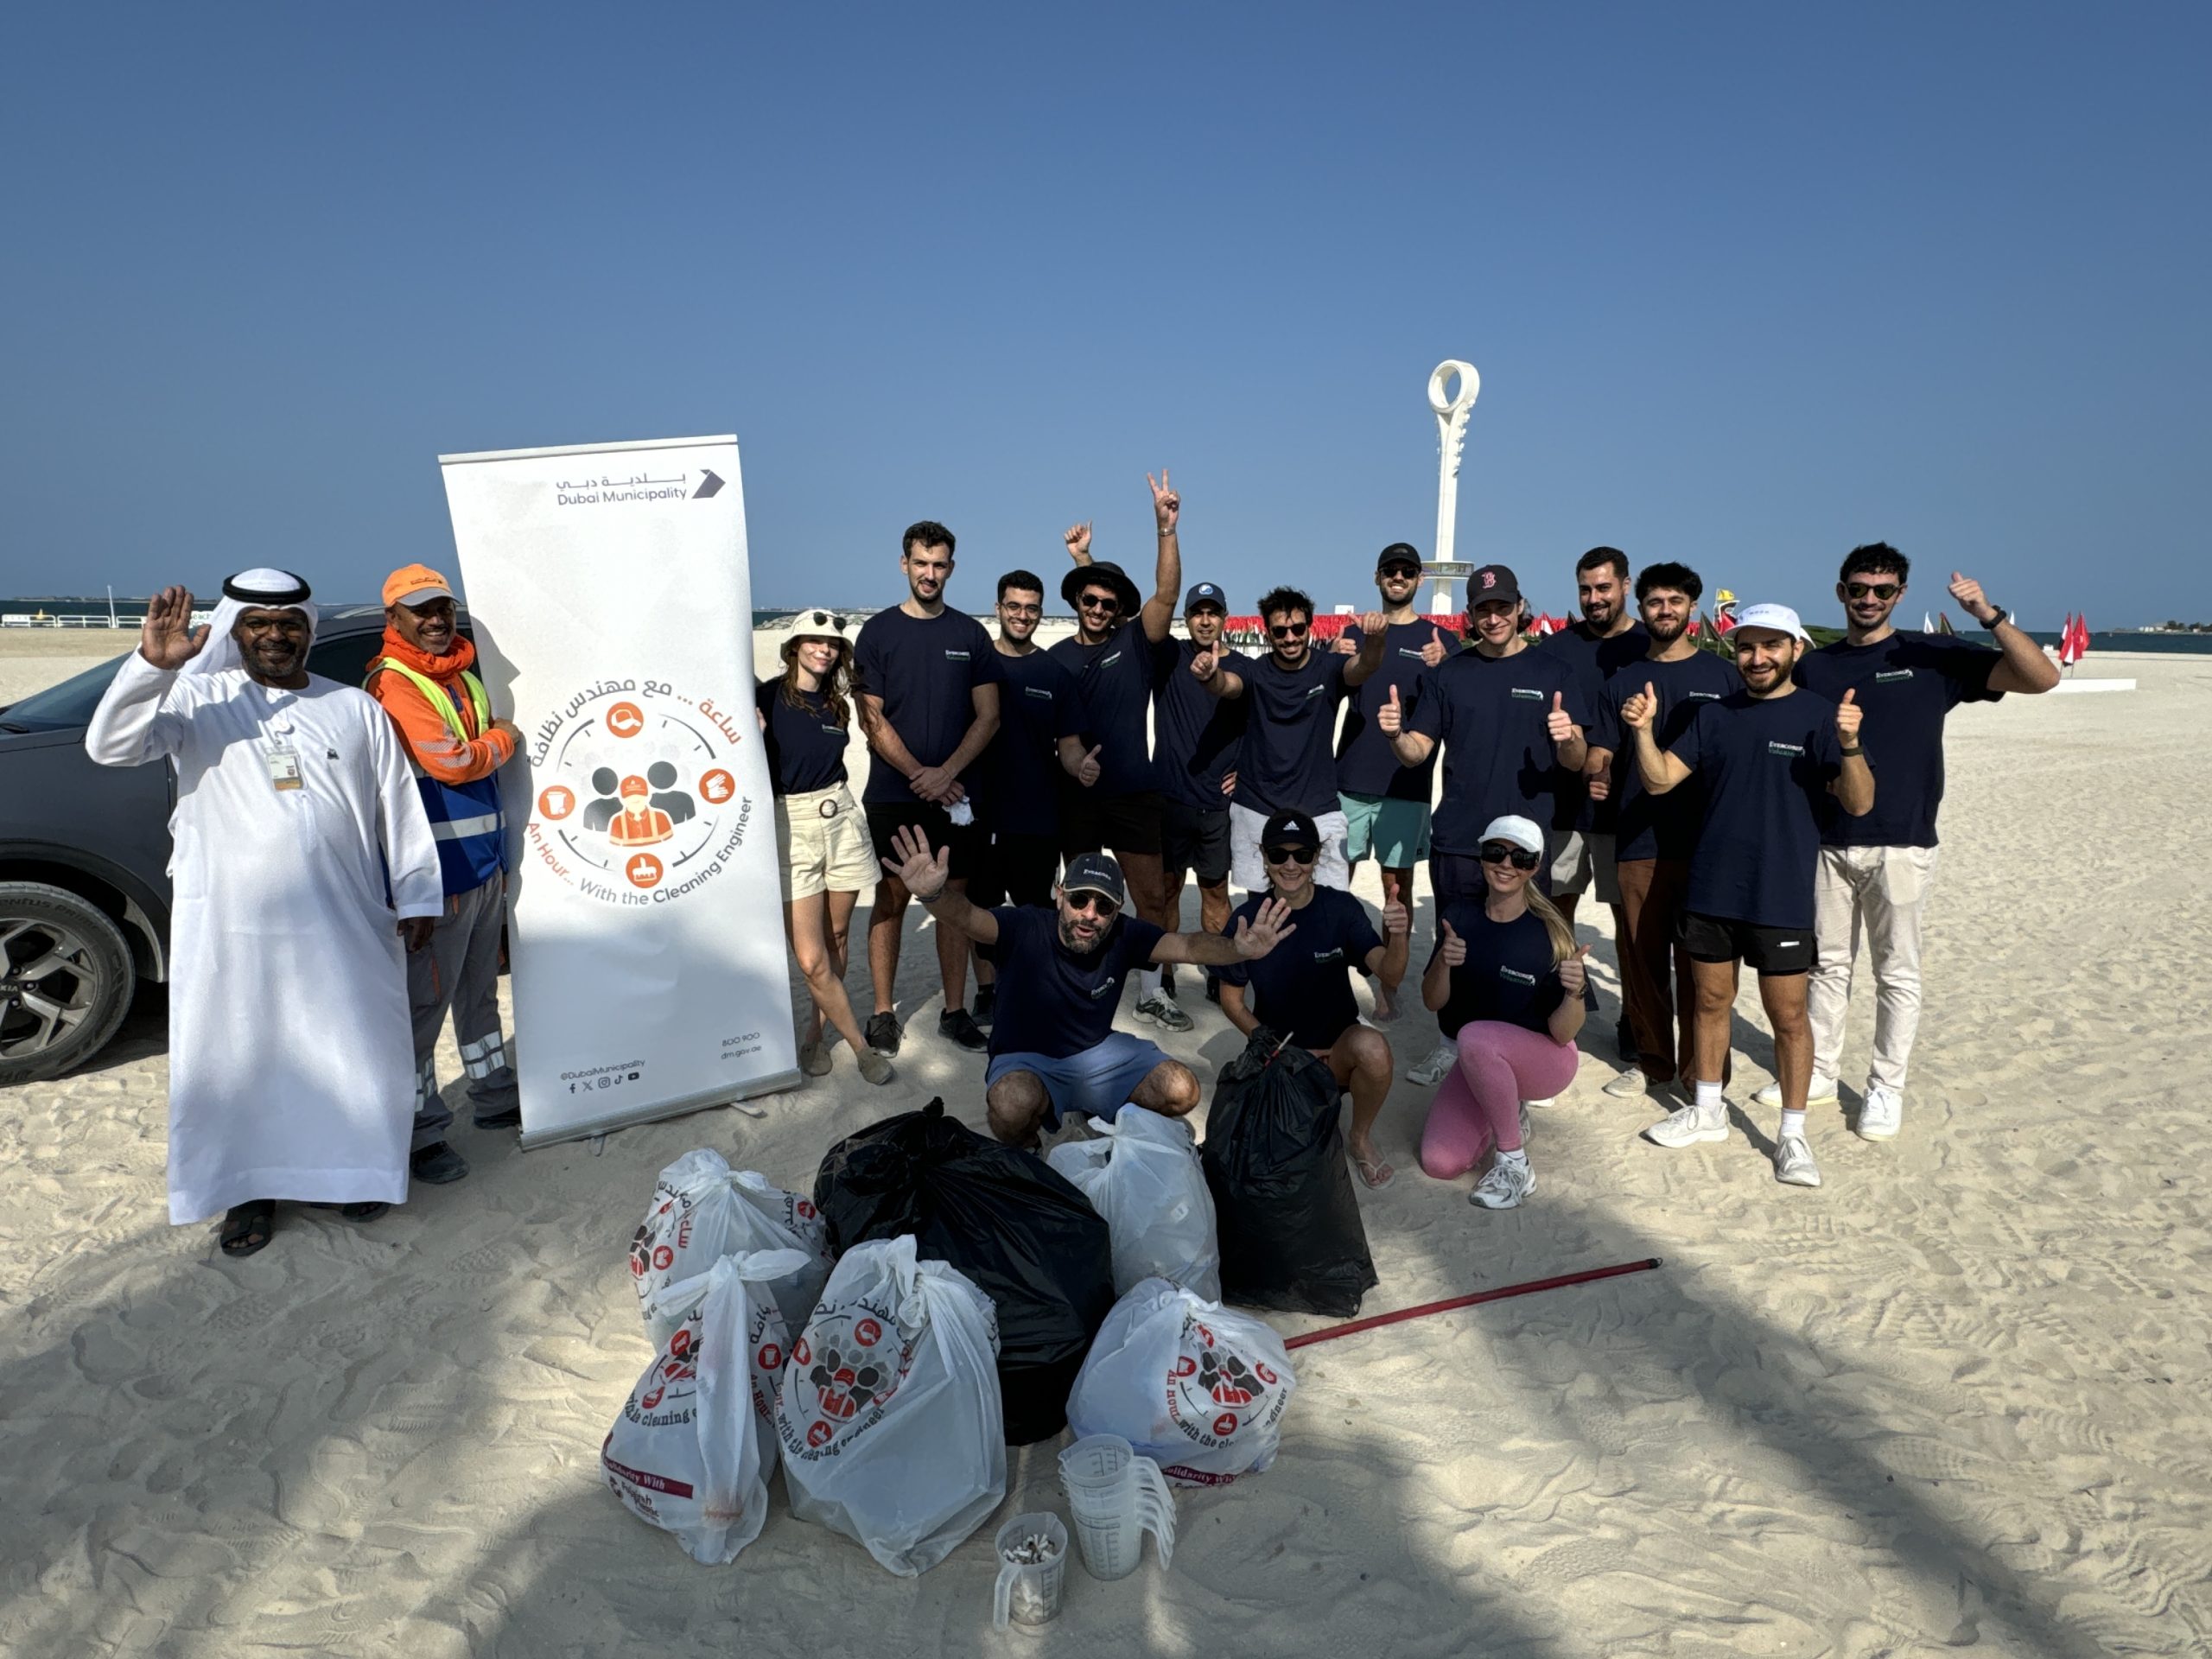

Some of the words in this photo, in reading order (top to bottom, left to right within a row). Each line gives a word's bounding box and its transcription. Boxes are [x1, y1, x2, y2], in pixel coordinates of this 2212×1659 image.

[556, 479, 598, 492] دبي
[557, 491, 600, 505] Dubai
[603, 486, 687, 502] Municipality
[642, 679, 672, 698] مع
[565, 678, 636, 719] مهندس
[698, 698, 742, 745] ساعة
[527, 822, 541, 841] An
[580, 877, 617, 904] With
[621, 892, 649, 906] the
[652, 861, 722, 904] Cleaning
[716, 796, 753, 862] Engineer
[721, 1036, 741, 1046] 800
[741, 1032, 760, 1042] 900
[721, 1046, 762, 1060] dm.gov.ae
[560, 1059, 646, 1081] @DubaiMunicipality
[643, 1473, 665, 1491] With
